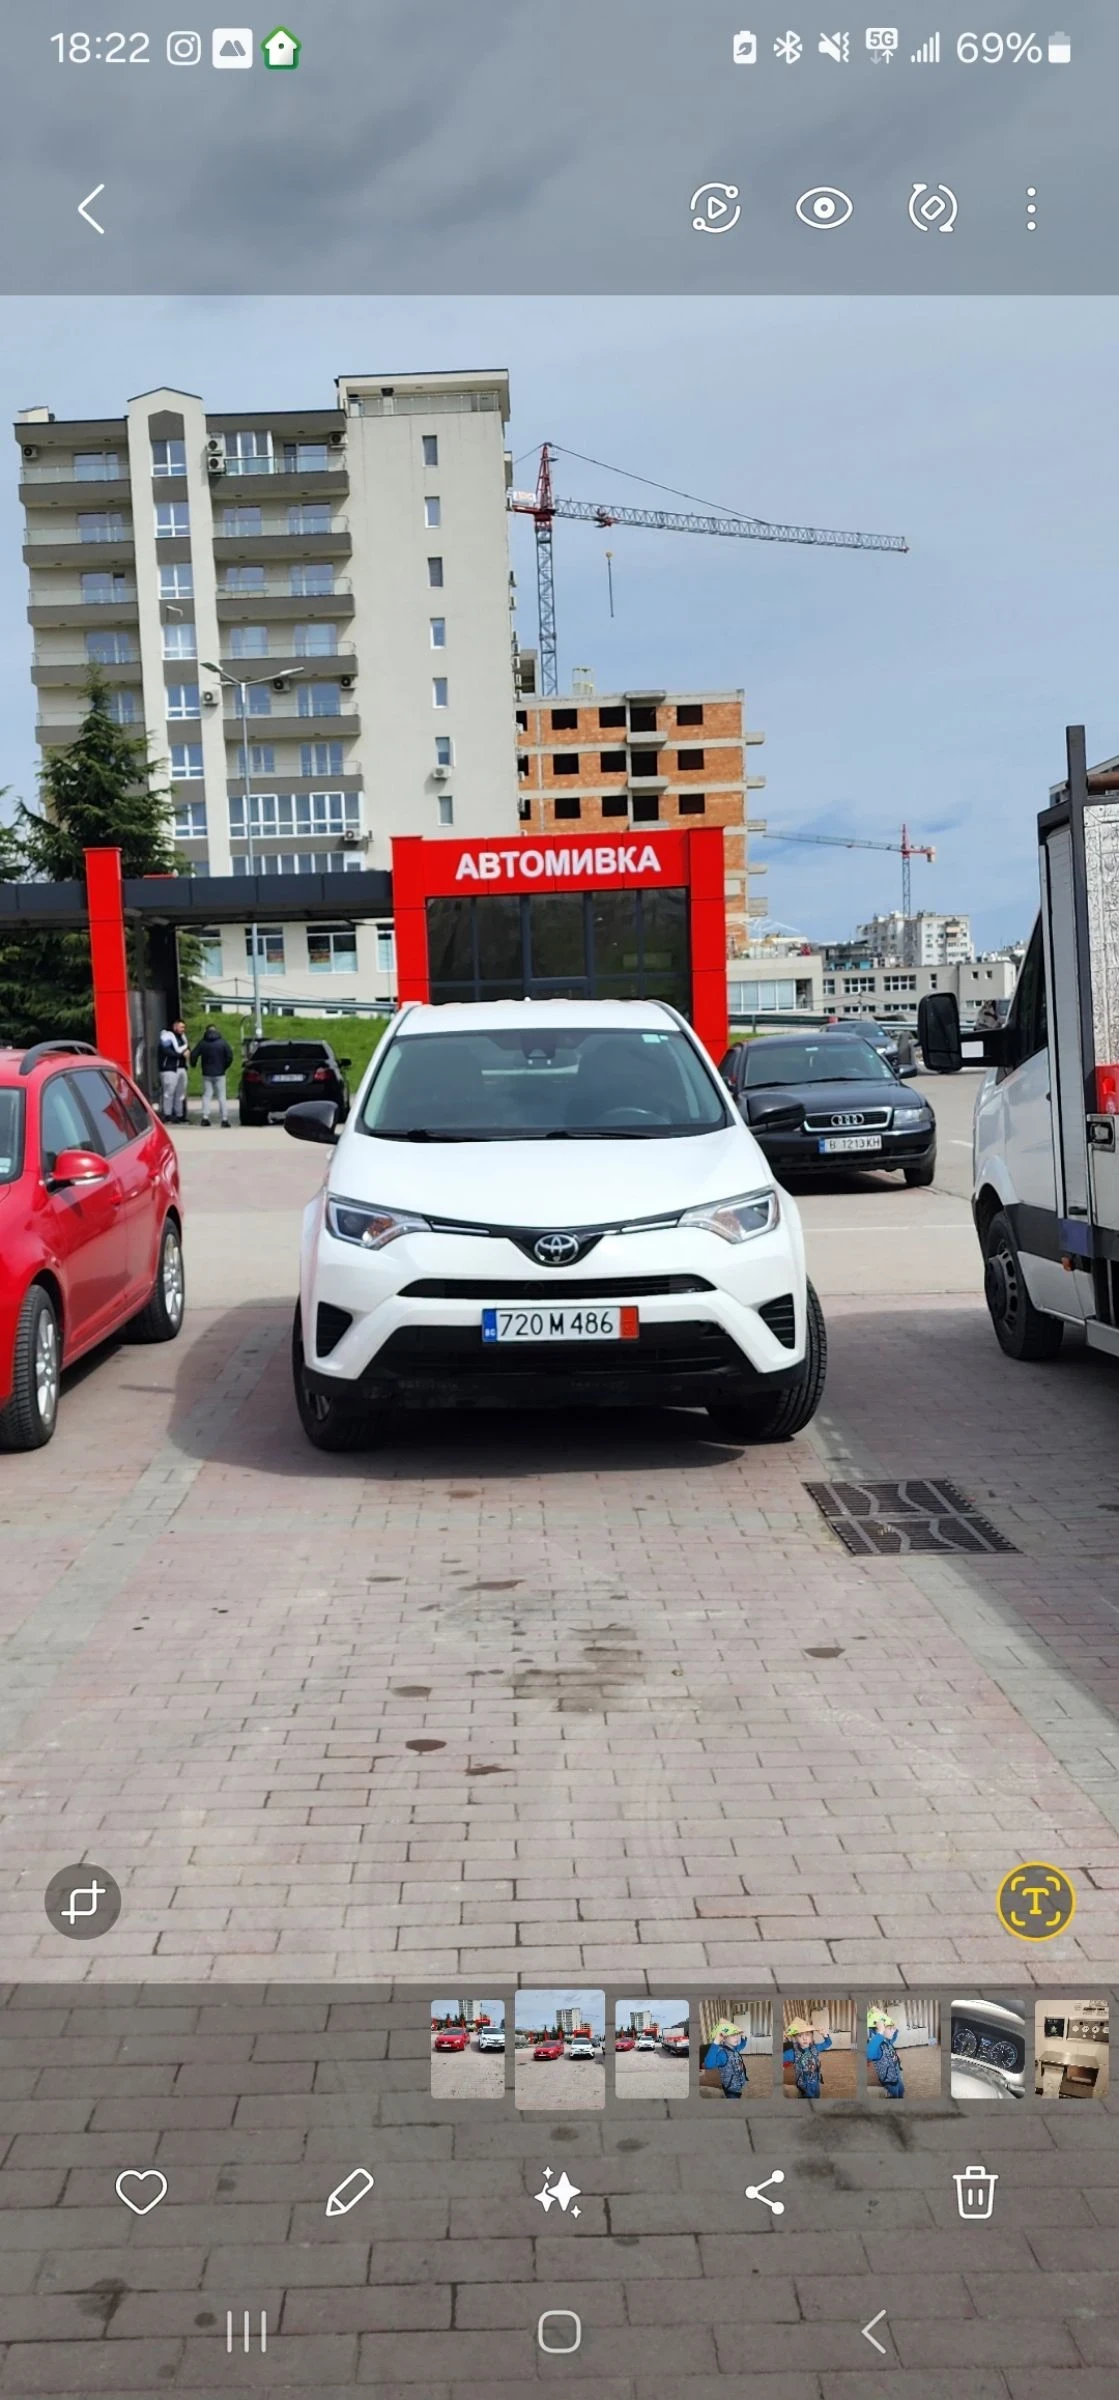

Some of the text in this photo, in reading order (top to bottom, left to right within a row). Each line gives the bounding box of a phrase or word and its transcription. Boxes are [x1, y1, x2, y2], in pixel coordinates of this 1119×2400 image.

[455, 846, 661, 880] АВТОМИВКА
[500, 1313, 544, 1336] 720
[550, 1312, 564, 1335] M
[570, 1311, 613, 1335] 486
